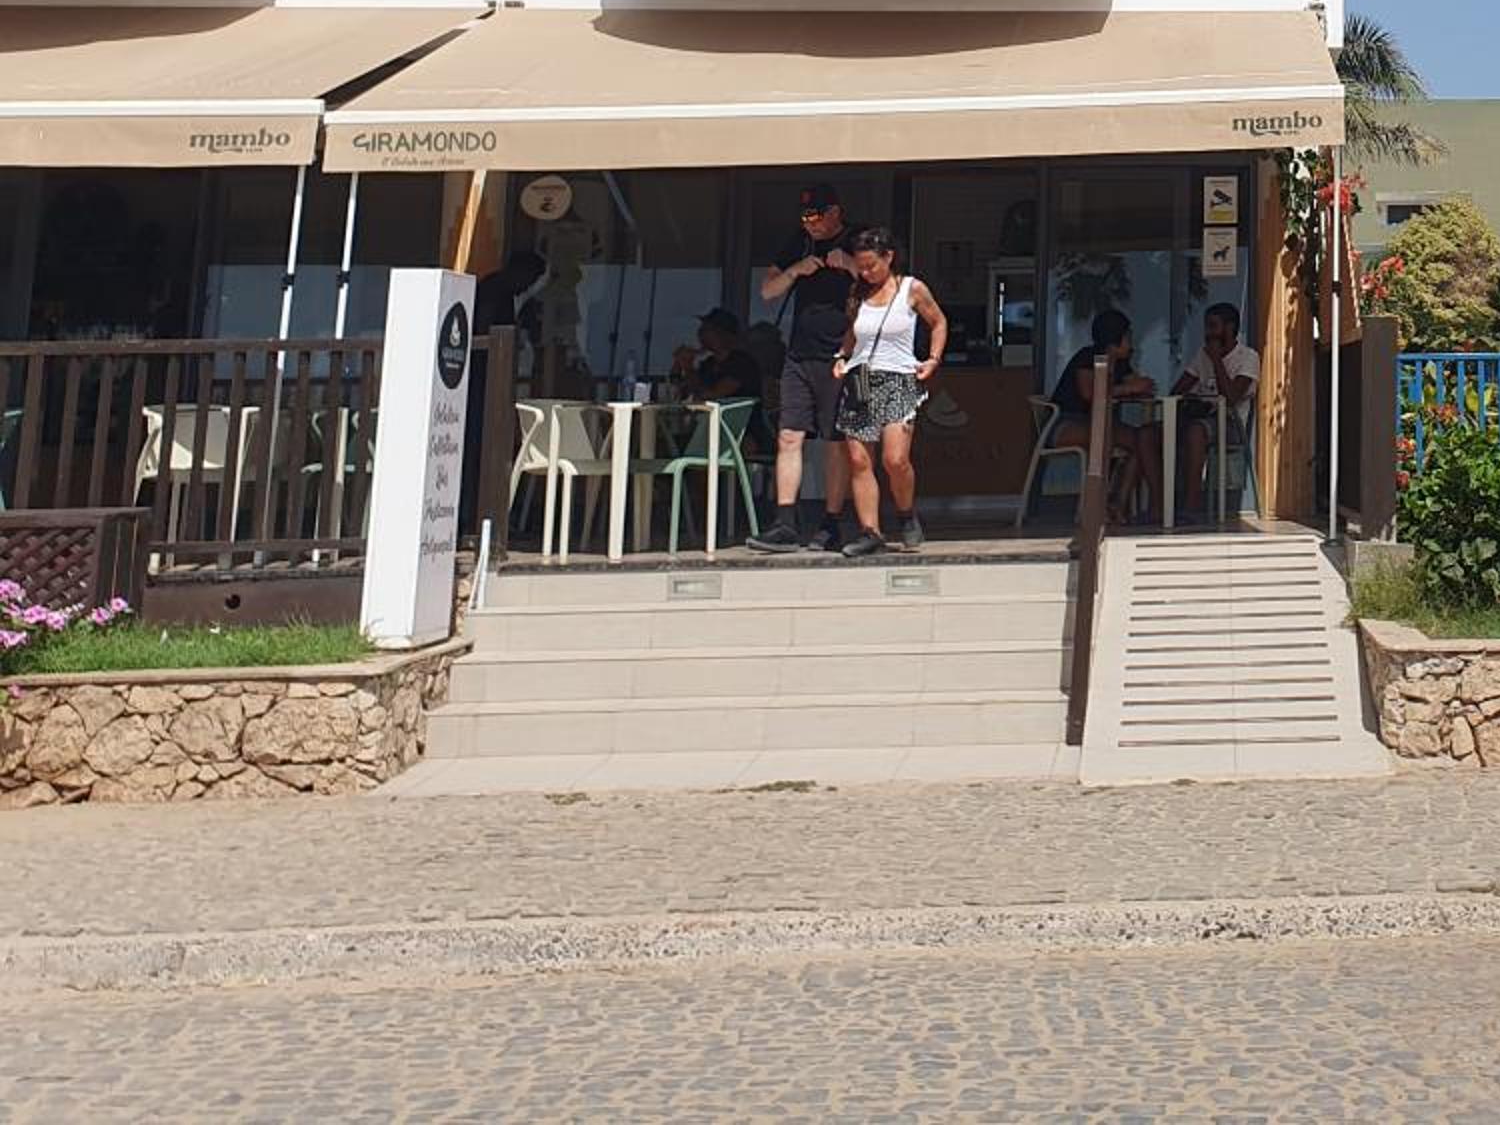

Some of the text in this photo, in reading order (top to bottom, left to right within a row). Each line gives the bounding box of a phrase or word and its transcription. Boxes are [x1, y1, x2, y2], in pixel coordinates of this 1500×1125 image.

[1232, 111, 1323, 136] mambo
[189, 127, 291, 153] mambo
[352, 130, 497, 152] GIRAMONDO
